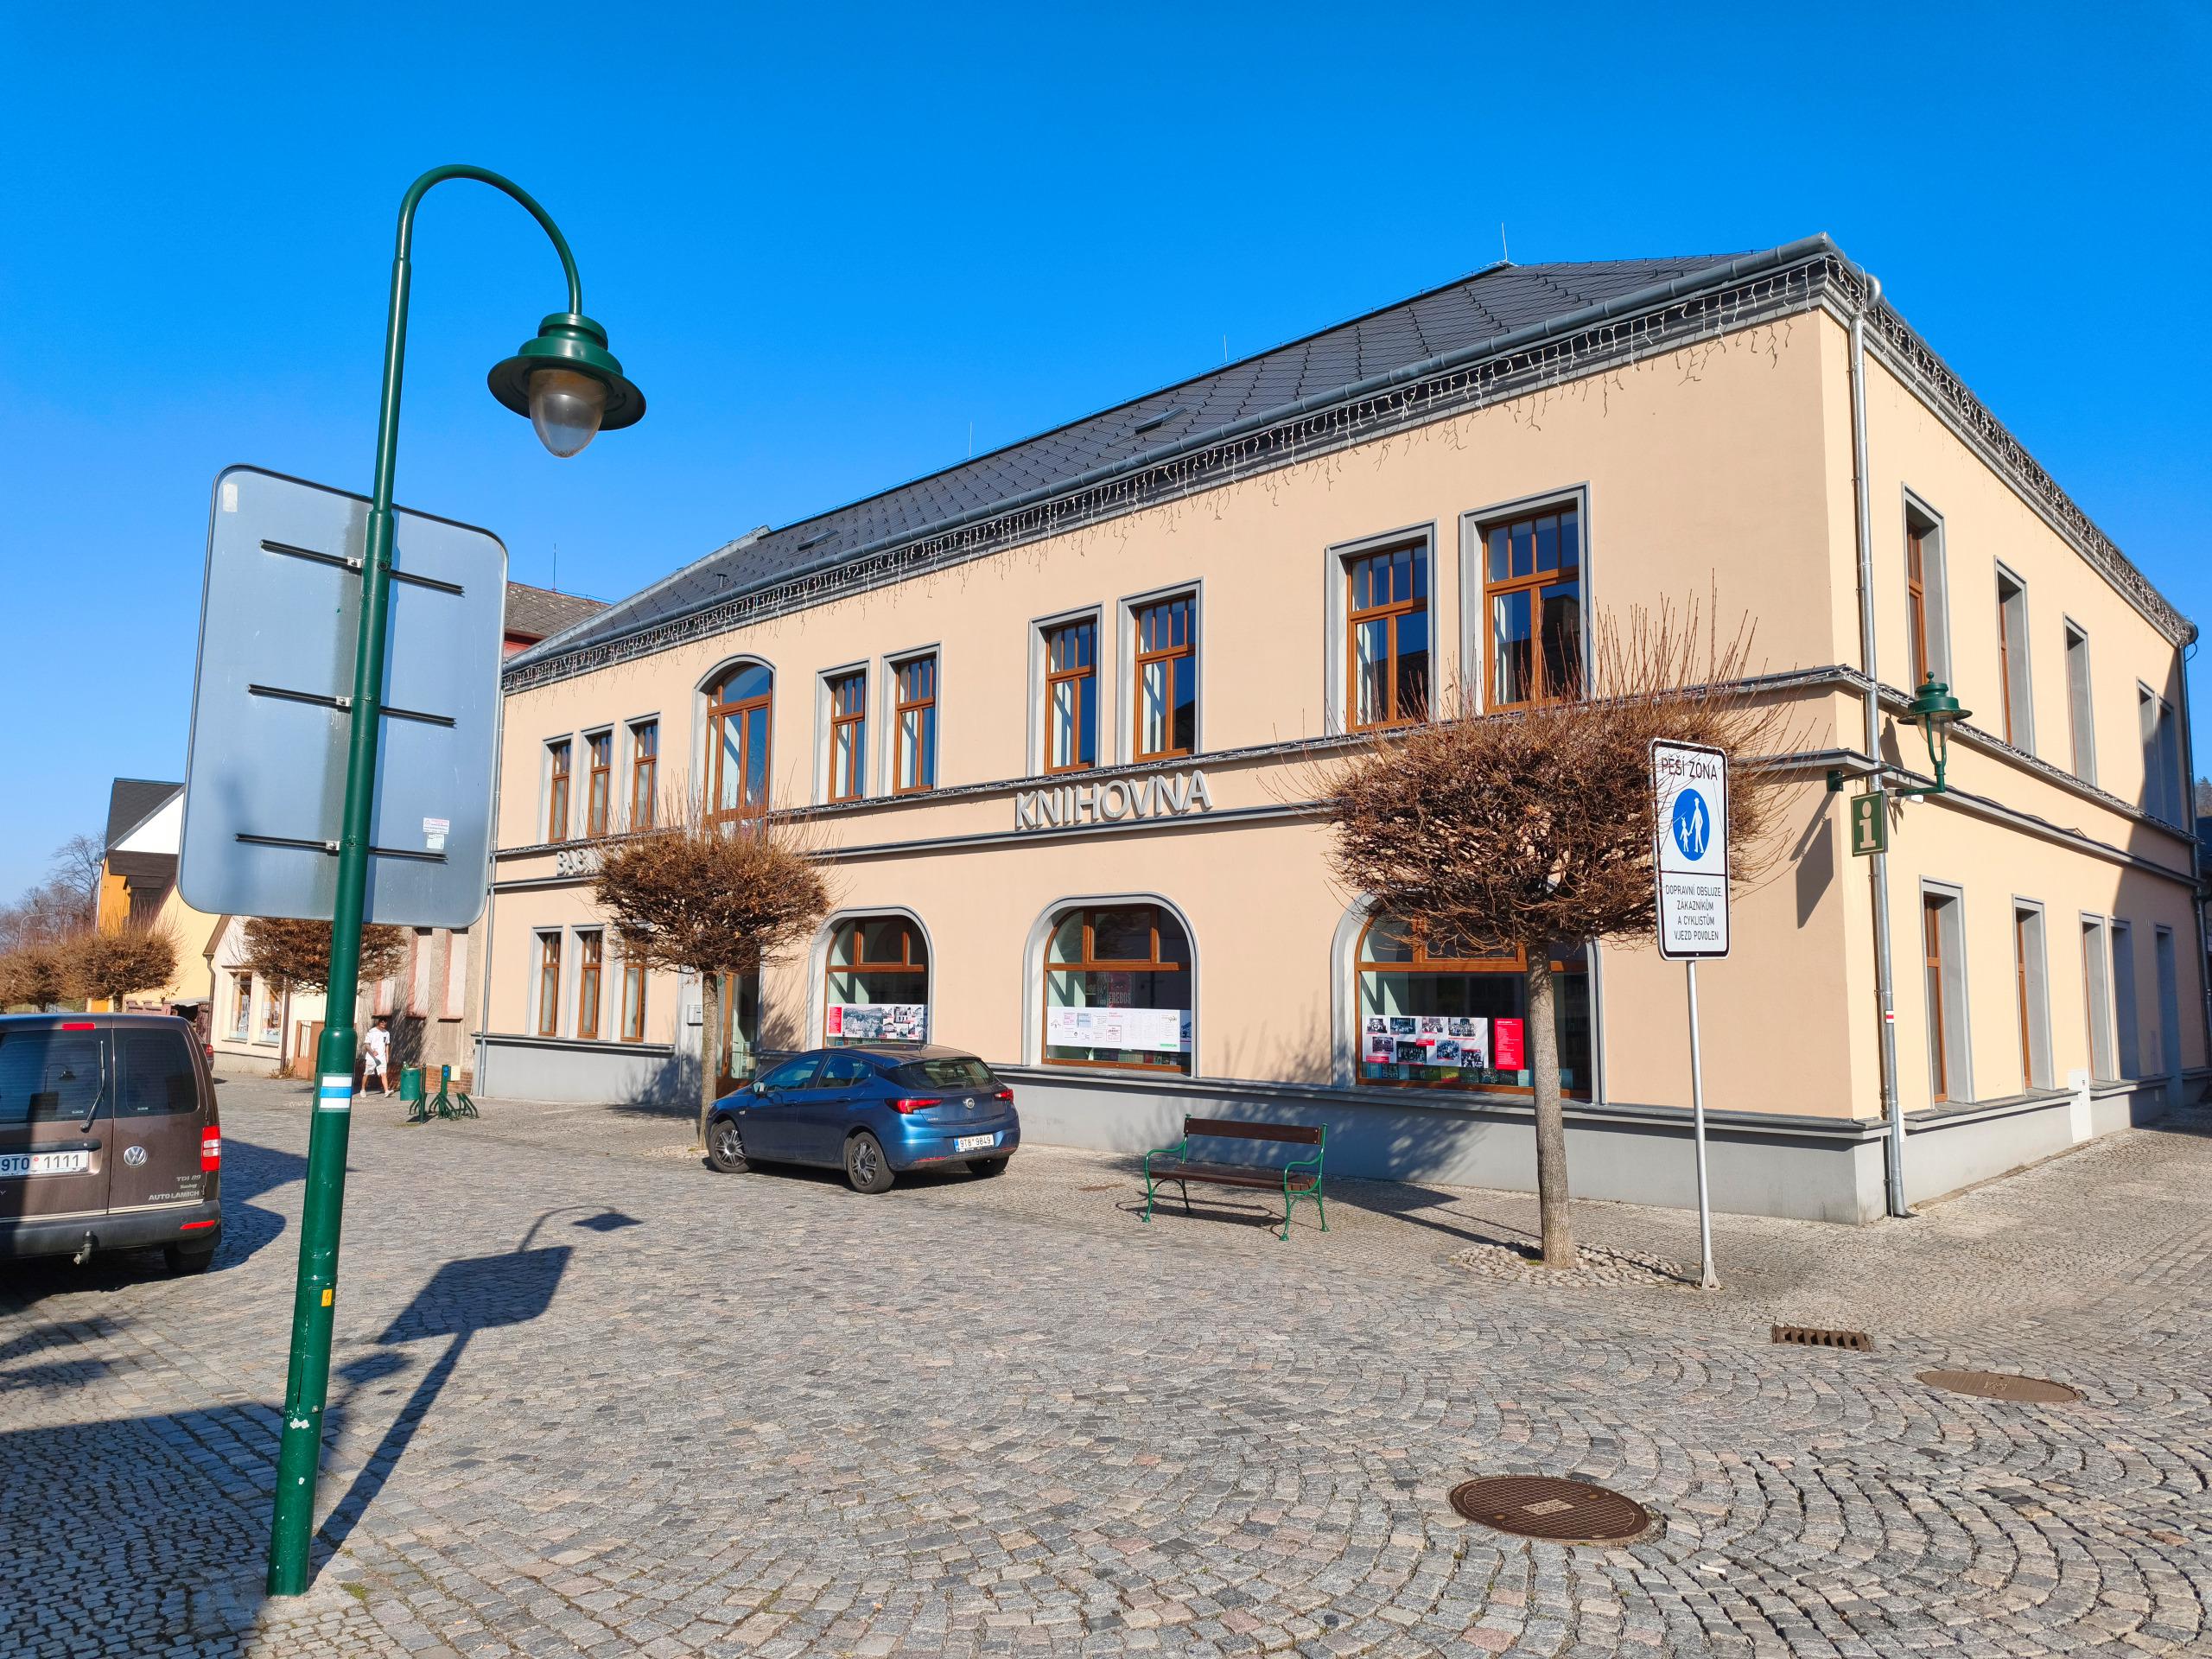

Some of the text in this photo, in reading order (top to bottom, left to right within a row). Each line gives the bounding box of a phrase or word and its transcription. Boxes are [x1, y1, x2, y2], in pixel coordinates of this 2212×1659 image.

[1661, 754, 1718, 780] PĚŠÍ ZÓNA
[1016, 770, 1212, 829] KNIHOVNA
[1665, 884, 1694, 896] DOPRAVNÍ
[1676, 898, 1714, 911] ZÁKAZNÍKŮM
[1677, 913, 1715, 926] A CYKLISTŮM
[1674, 931, 1719, 941] VJEZD POVOLEN
[43, 1154, 79, 1169] 1111
